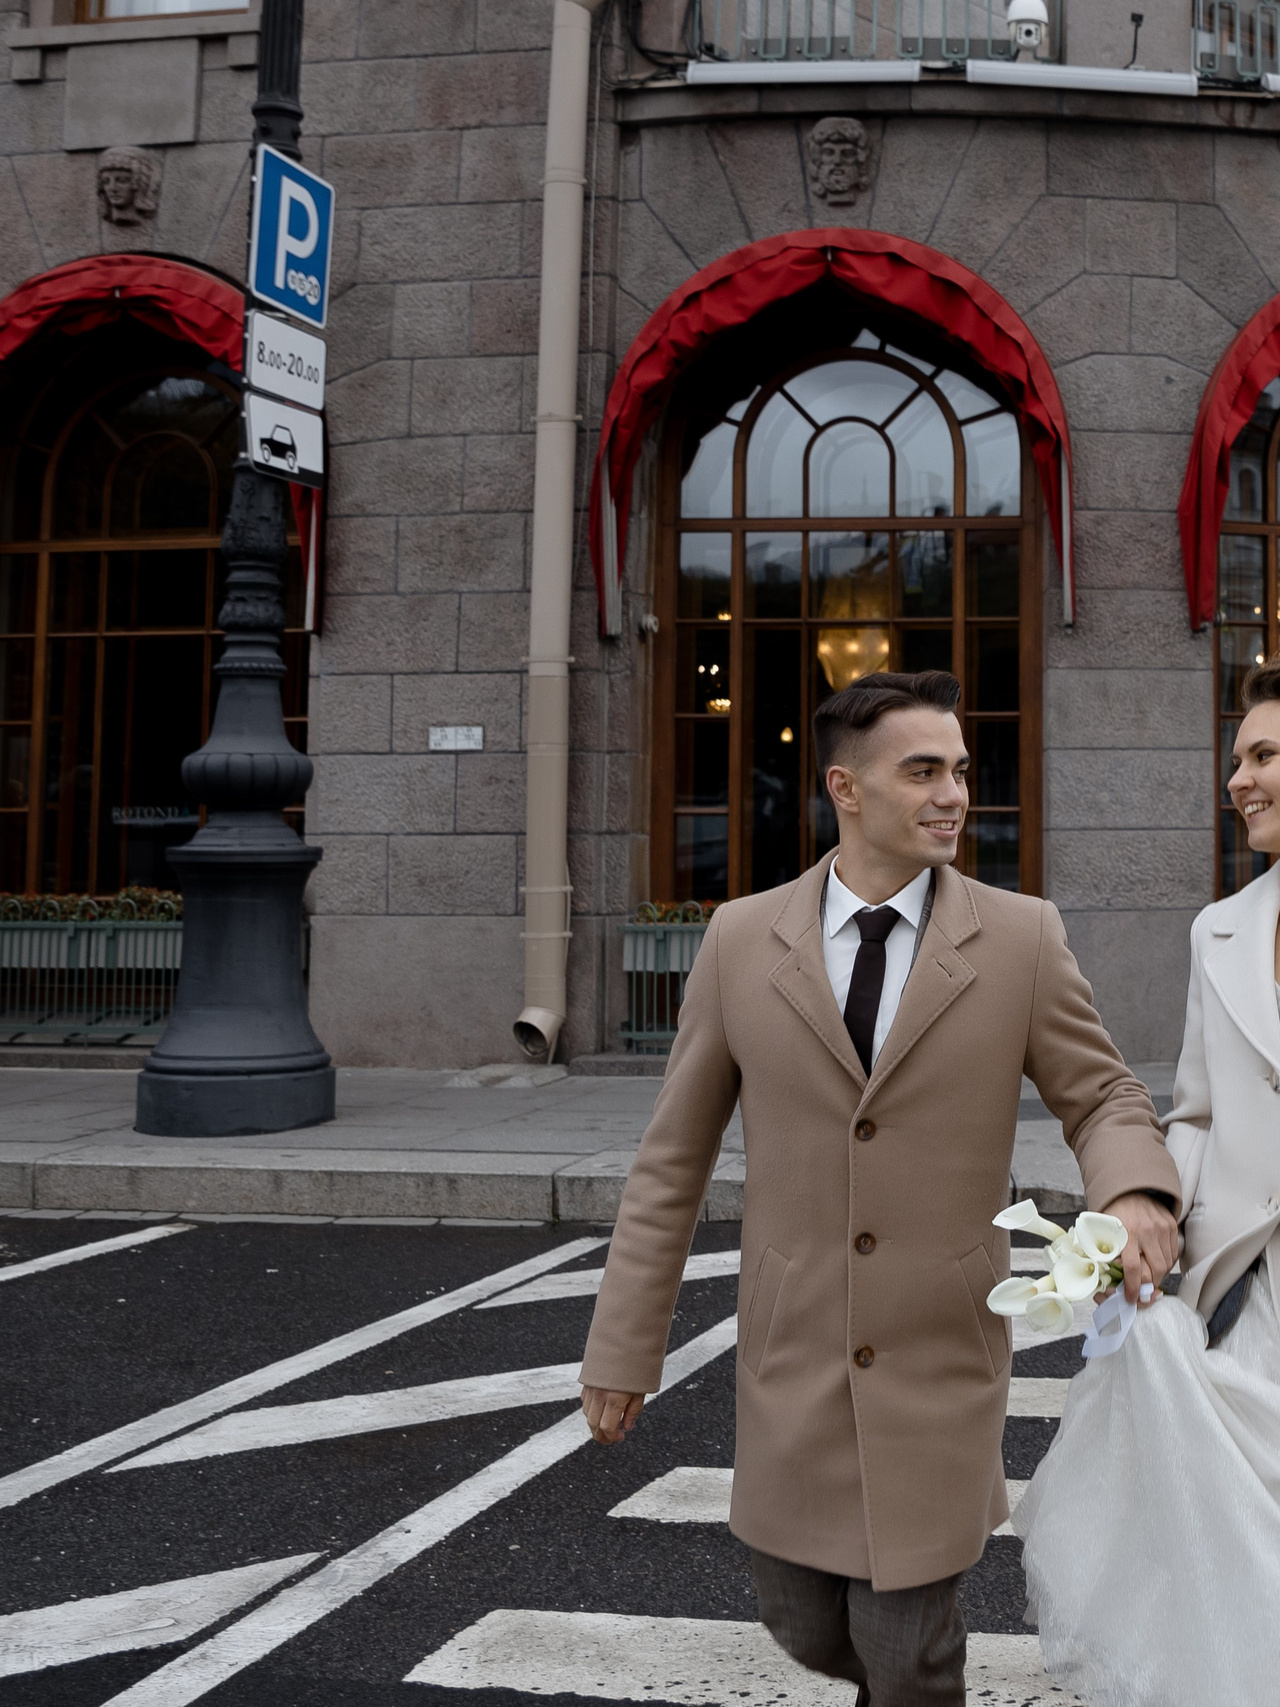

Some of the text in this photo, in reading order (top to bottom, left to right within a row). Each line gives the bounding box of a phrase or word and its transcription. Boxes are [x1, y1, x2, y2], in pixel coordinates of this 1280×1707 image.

[273, 174, 320, 290] P
[307, 280, 319, 299] 20
[256, 340, 320, 384] 8.00-20.00
